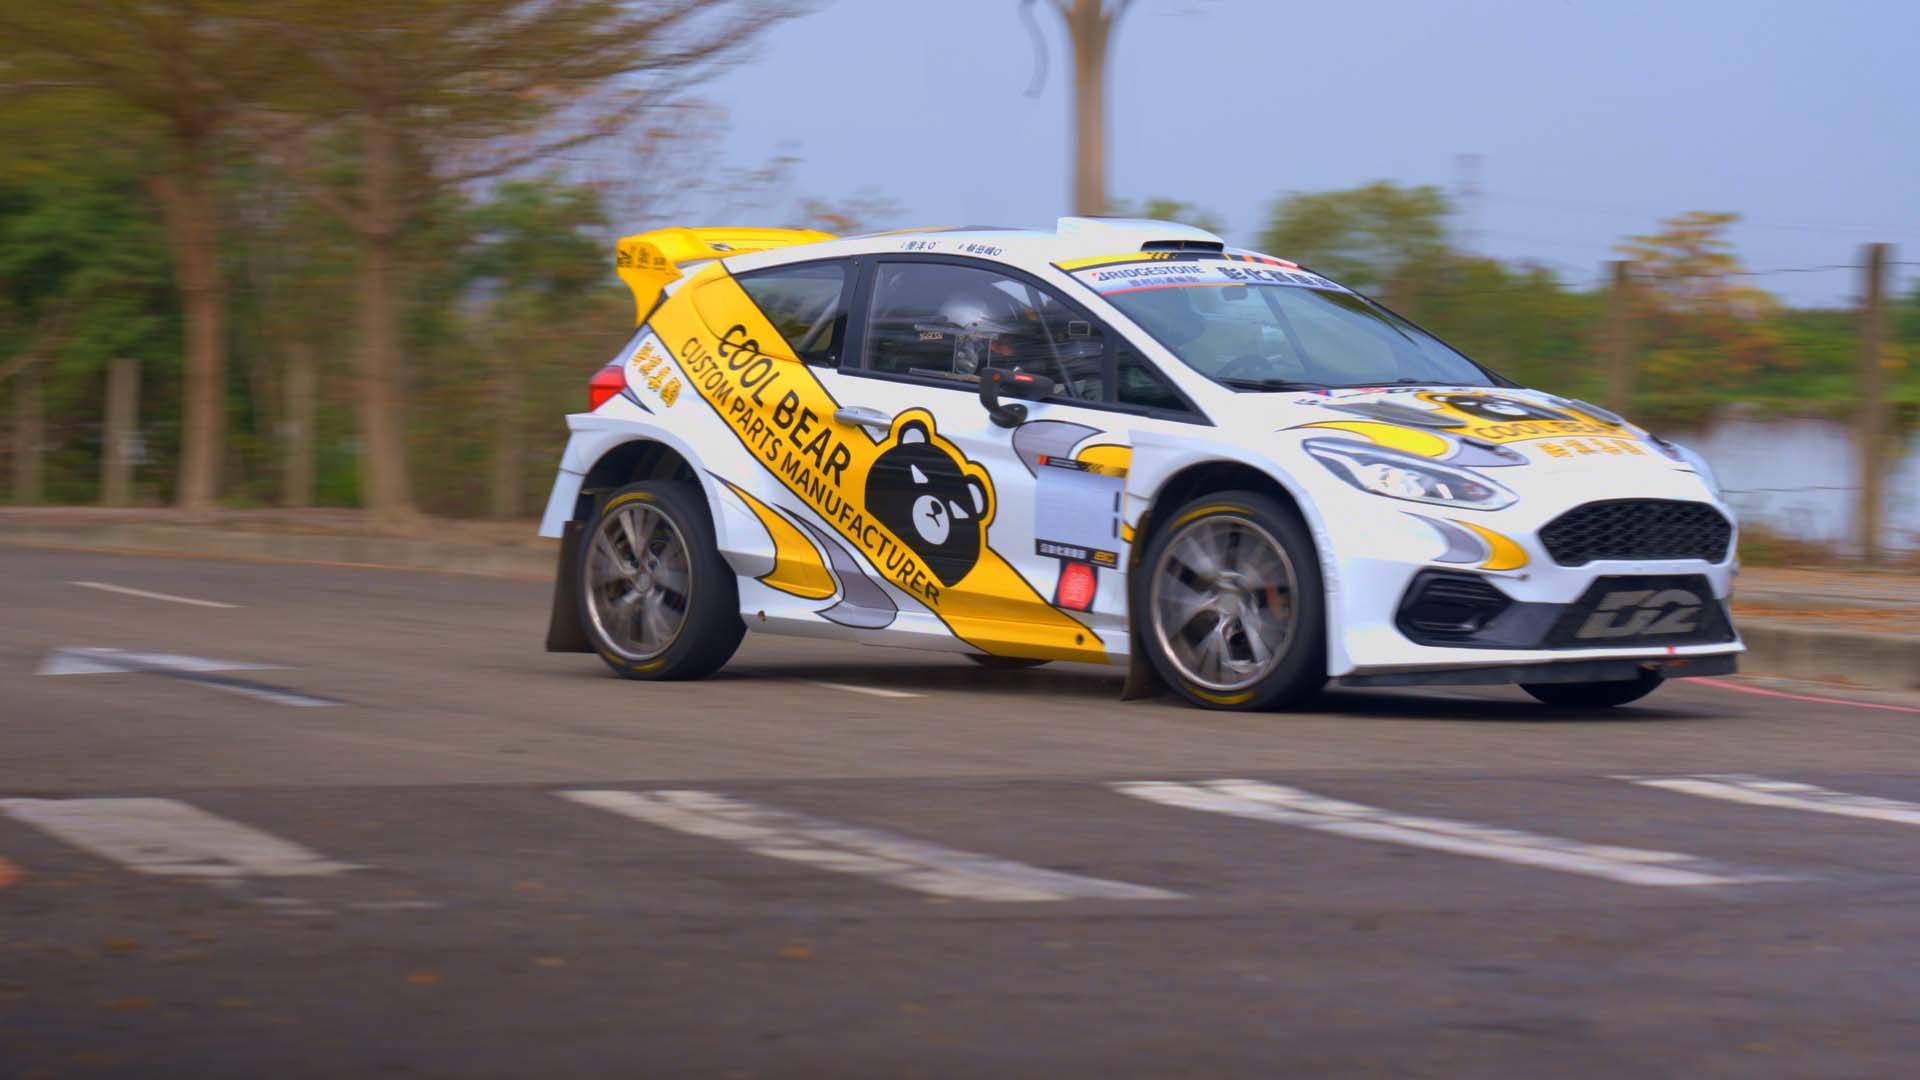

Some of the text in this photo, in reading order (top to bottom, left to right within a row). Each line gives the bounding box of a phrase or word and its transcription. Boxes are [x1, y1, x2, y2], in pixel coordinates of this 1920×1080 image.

[1091, 265, 1206, 281] BRIDGESTONE
[718, 324, 851, 488] COOL BEAR
[1474, 422, 1556, 439] COOL
[681, 337, 941, 606] CUSTOM PARTS MANUFACTURER
